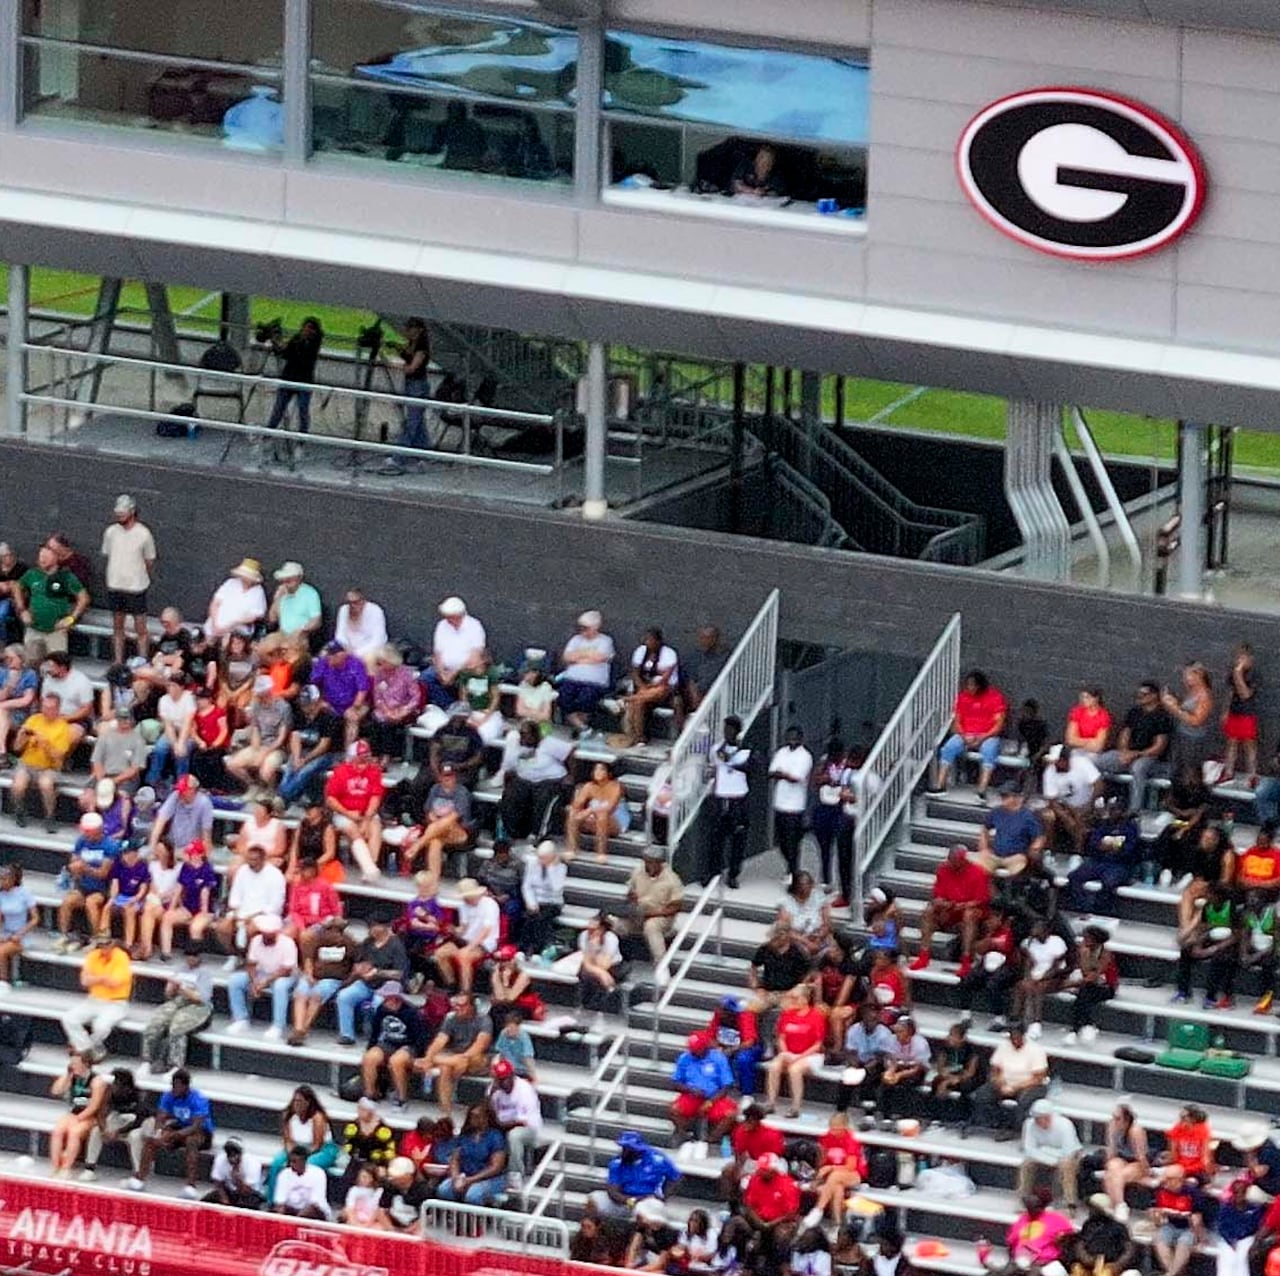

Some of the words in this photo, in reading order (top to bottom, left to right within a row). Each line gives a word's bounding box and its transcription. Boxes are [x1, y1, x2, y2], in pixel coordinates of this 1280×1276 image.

[968, 100, 1188, 248] G
[8, 1240, 80, 1265] TRACK
[96, 1254, 151, 1276] CLUB
[11, 1208, 152, 1258] ATLANTA
